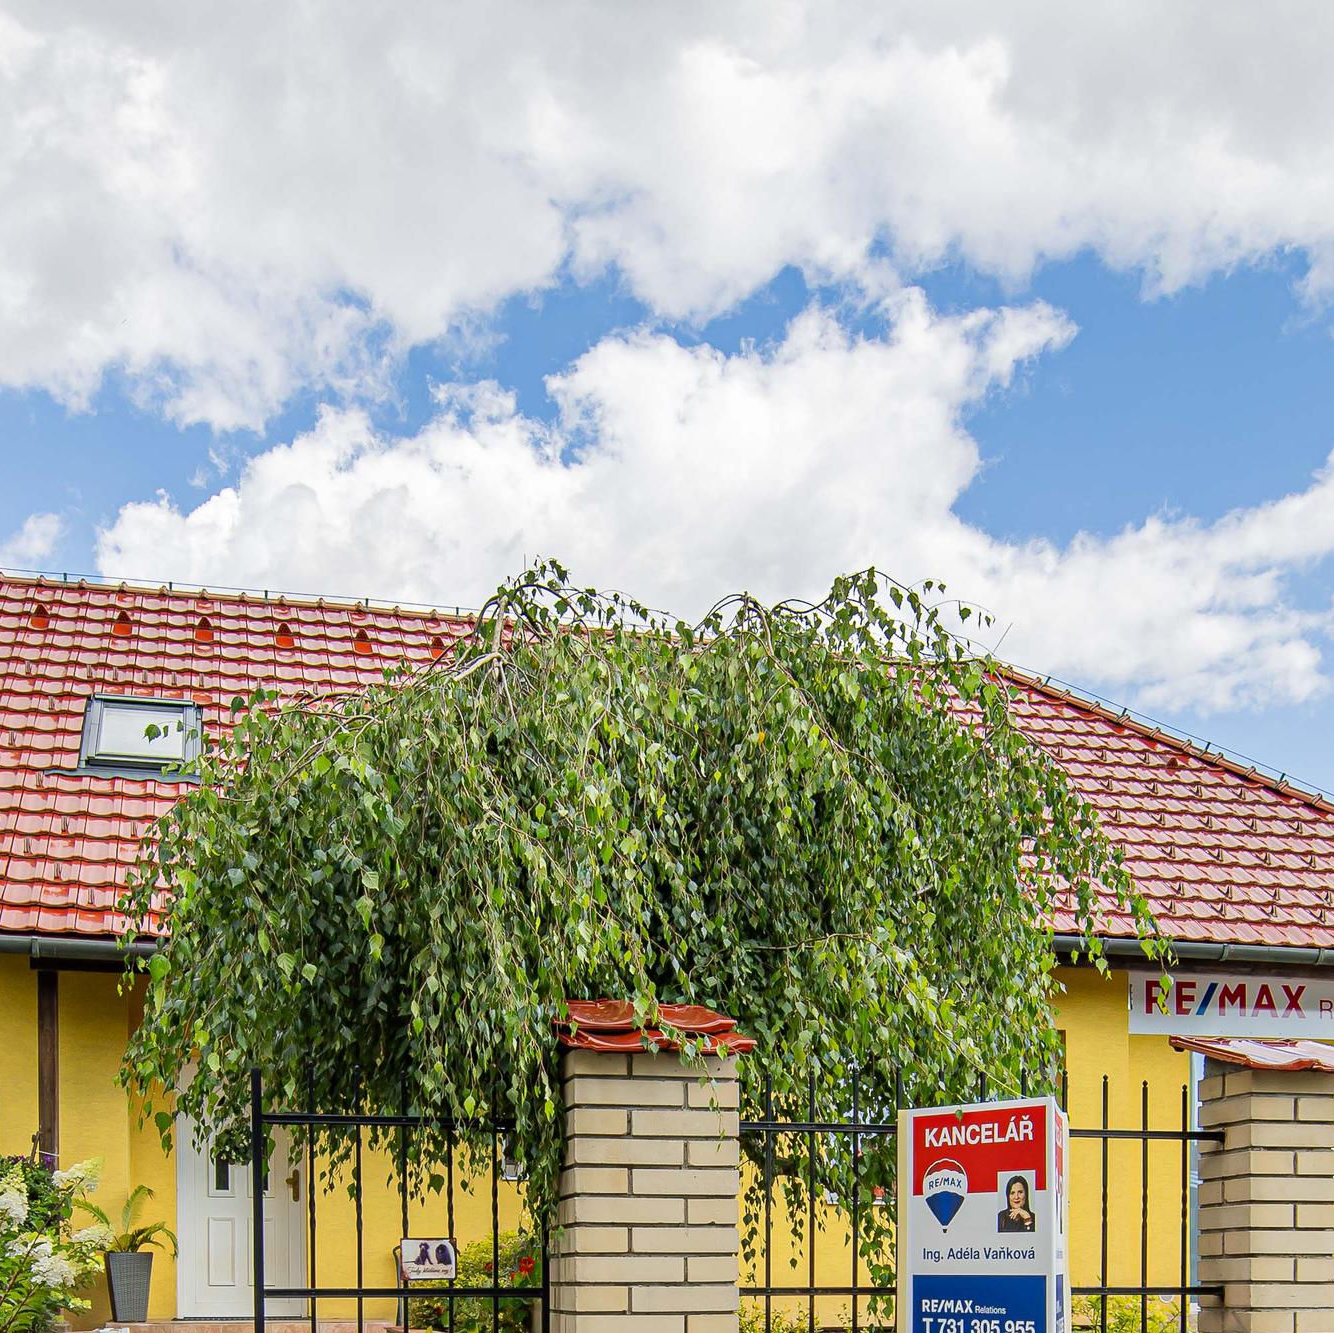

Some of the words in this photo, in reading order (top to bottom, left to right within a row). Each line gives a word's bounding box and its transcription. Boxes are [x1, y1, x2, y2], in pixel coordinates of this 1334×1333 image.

[1145, 980, 1307, 1019] RE/MAX
[924, 1115, 1034, 1148] KANCELÁŘ
[928, 1177, 963, 1191] RE/MAX
[922, 1247, 945, 1263] Ing.
[947, 1246, 981, 1260] Adéla
[983, 1246, 1036, 1260] Vaňková
[921, 1299, 974, 1314] RE/MAX
[974, 1305, 1007, 1315] Relations
